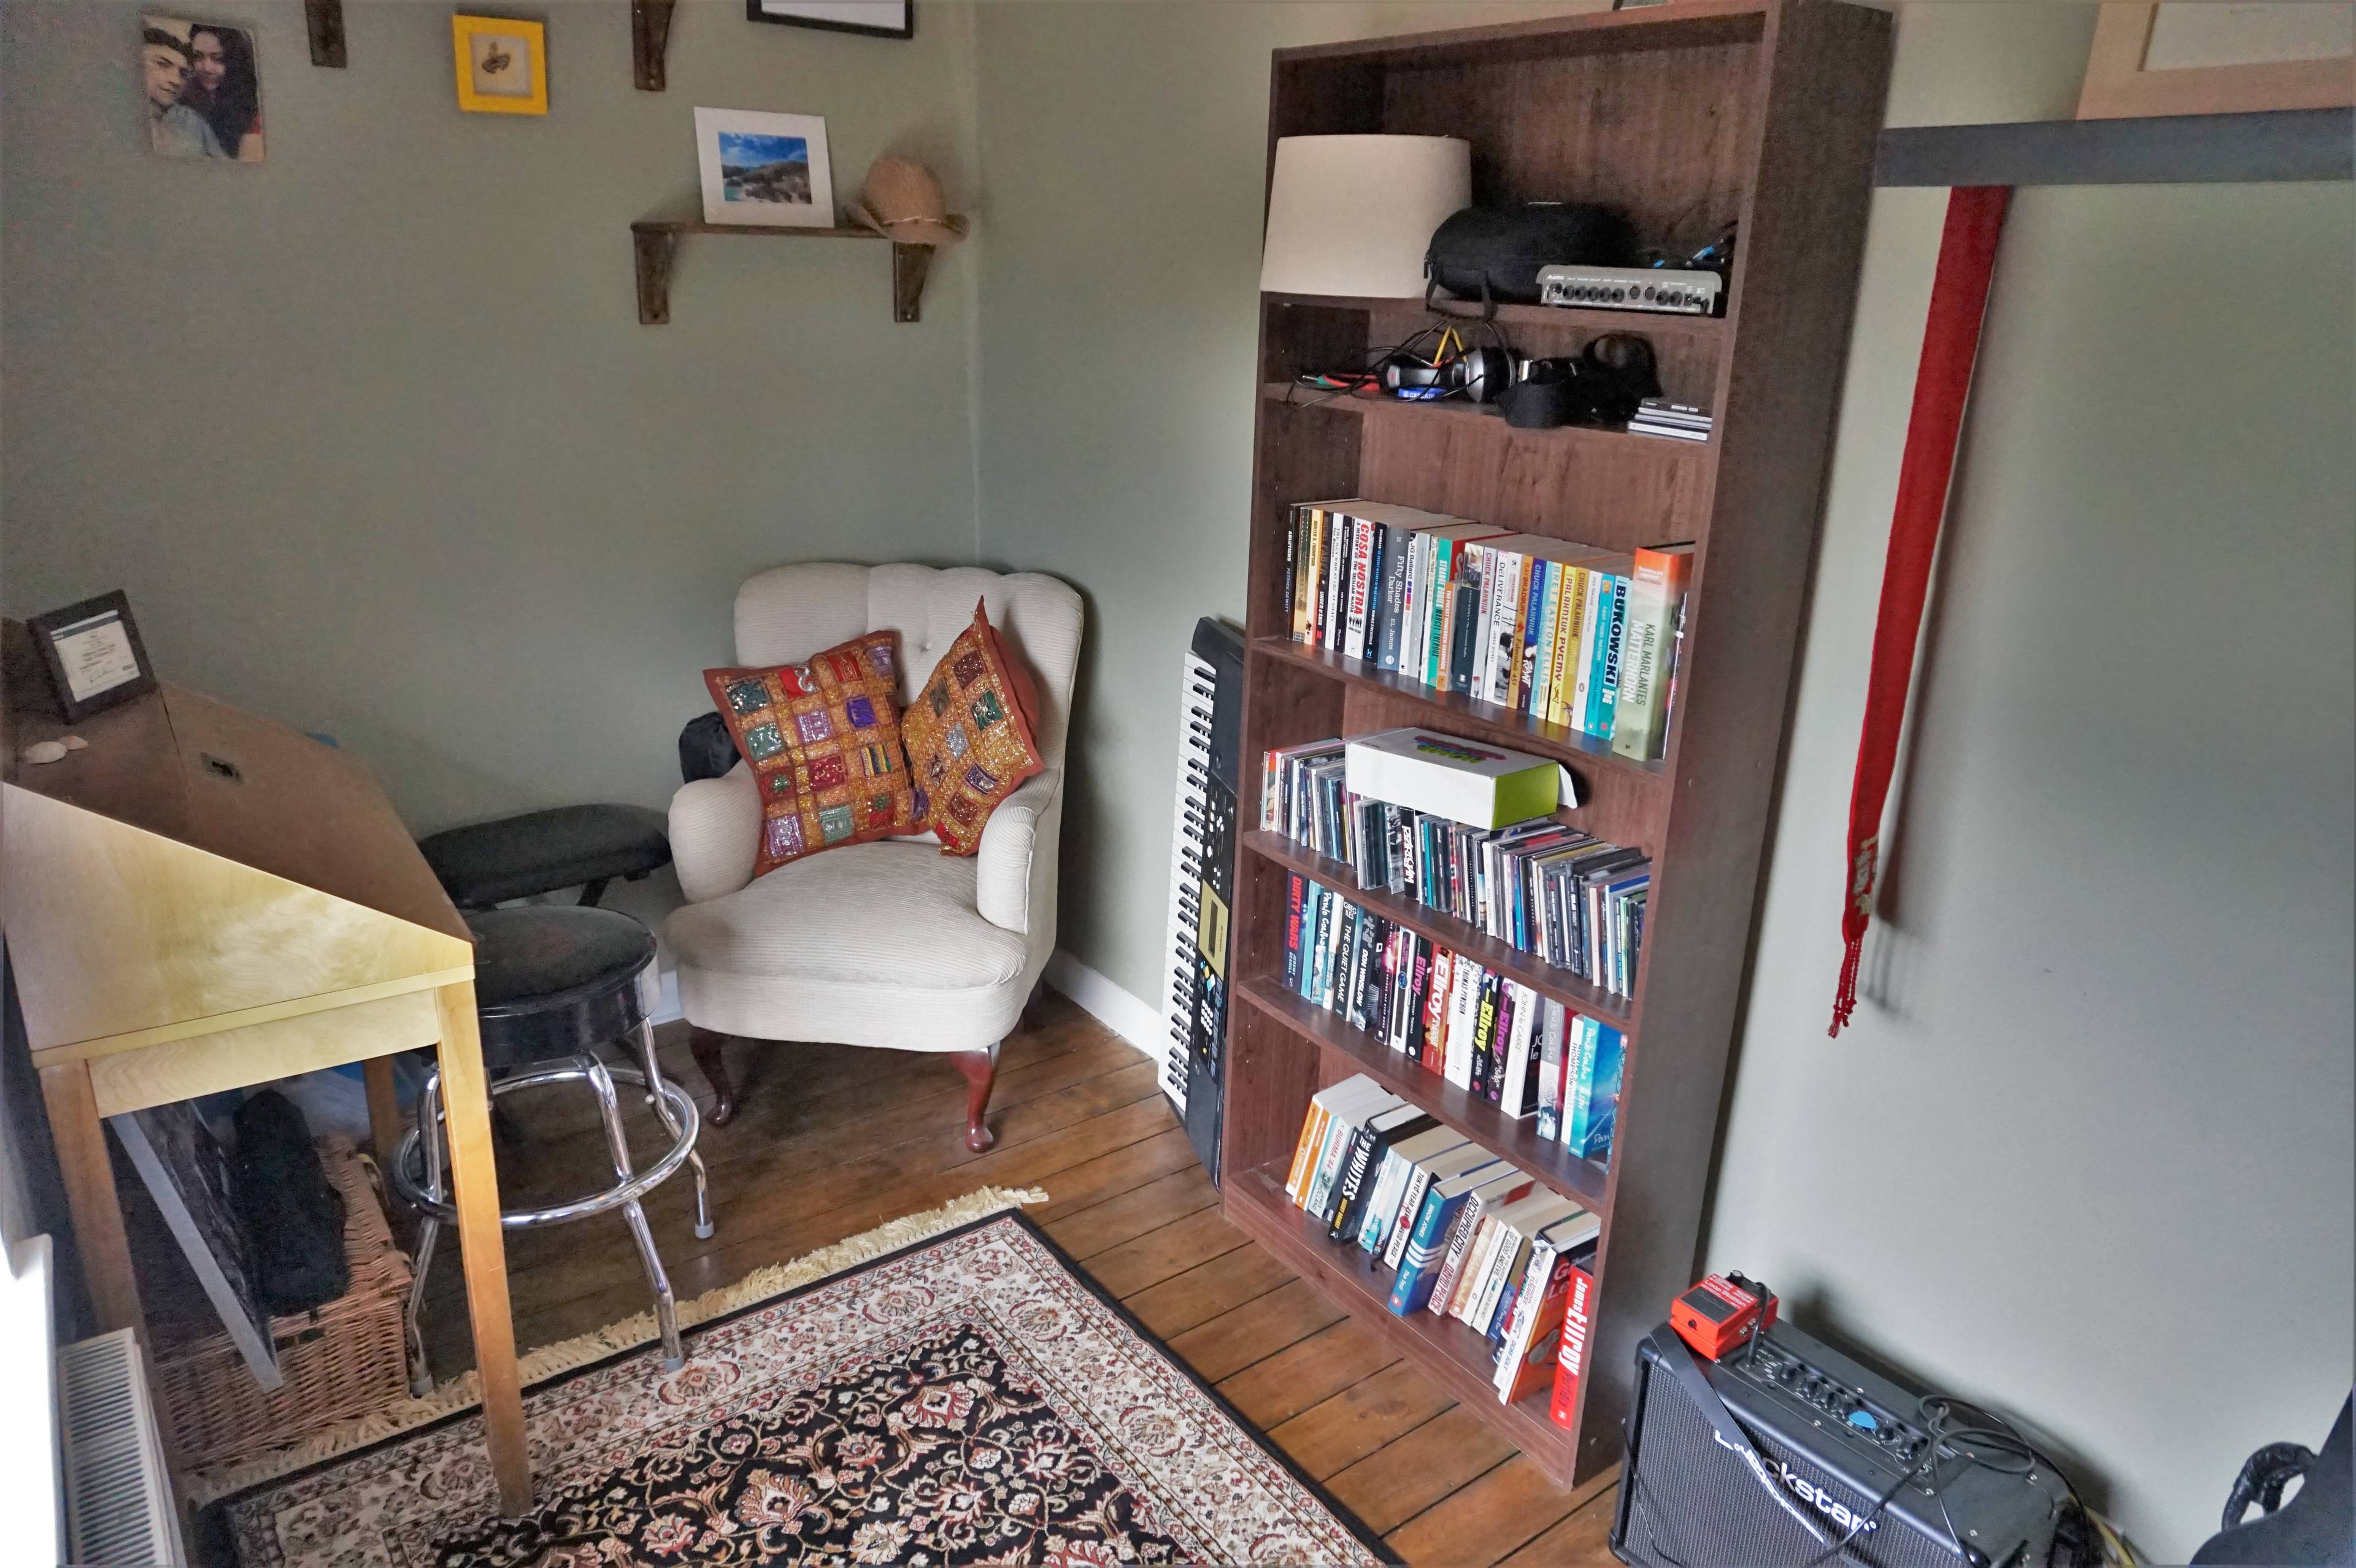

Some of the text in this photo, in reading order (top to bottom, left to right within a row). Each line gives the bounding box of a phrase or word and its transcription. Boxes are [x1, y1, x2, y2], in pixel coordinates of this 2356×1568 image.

[1410, 543, 1415, 553] JG
[1354, 523, 1369, 615] COSA NOSTRA
[1439, 559, 1447, 586] STRANGE
[1393, 581, 1403, 613] Shades
[1481, 578, 1490, 615] PALAHNIUK
[1493, 562, 1506, 626] DeLIVERANCE
[1519, 577, 1529, 617] BRADBURY
[1390, 618, 1396, 627] EL
[1434, 609, 1442, 632] MARCEL
[1522, 564, 1542, 689] CHUCK PALAHNIUK RANT
[1542, 565, 1561, 683] BRET EASTON ELLIS
[1556, 577, 1572, 682] PALAHNIUK PYGMY
[1568, 572, 1585, 675] CHUCK PALAHNIUK SURVIVOR
[1604, 585, 1626, 684] BUKOWSKI
[1512, 639, 1522, 672] Fahrenheit
[1623, 620, 1645, 703] MATTERHORN
[1636, 648, 1653, 707] MARLANTES
[1401, 825, 1414, 883] PEARL JAM
[1288, 876, 1302, 950] DIRTY WARS
[1319, 892, 1331, 946] Paulo Coelho
[1344, 901, 1356, 914] GREG
[1341, 942, 1350, 973] QUIET
[1412, 955, 1426, 996] Ellroy
[1337, 973, 1346, 1002] GAME
[1356, 967, 1367, 1007] WINSLOW
[1428, 958, 1449, 1019] Ellroy
[1458, 968, 1470, 1015] THOMAS PYNCHON
[1519, 991, 1530, 1017] JOHN
[1475, 1000, 1493, 1051] Ellroy
[1494, 1010, 1509, 1056] Ellroy
[1517, 1017, 1523, 1025] le
[1585, 1027, 1595, 1050] Paulo
[1549, 1032, 1557, 1061] Coelho
[1581, 1051, 1592, 1080] Coelho
[1330, 1129, 1343, 1157] BURMA
[1360, 1135, 1371, 1152] THE
[1343, 1146, 1369, 1201] WHITES
[1413, 1172, 1424, 1193] TOKYO
[1312, 1183, 1323, 1210] HOLLAND
[1408, 1192, 1418, 1209] YEAR
[1419, 1203, 1434, 1238] SIMON JONES
[1451, 1196, 1479, 1258] OCCUPIED CITY
[1503, 1237, 1512, 1255] GOOD
[1430, 1261, 1454, 1313] DAVID PEACE
[1523, 1275, 1534, 1307] TOURIST
[1575, 1277, 1588, 1313] James
[1704, 1280, 1746, 1307] Loop Station
[1558, 1307, 1587, 1377] Ellroy
[1504, 1353, 1512, 1371] JOLY
[1560, 1370, 1574, 1409] Perfidia
